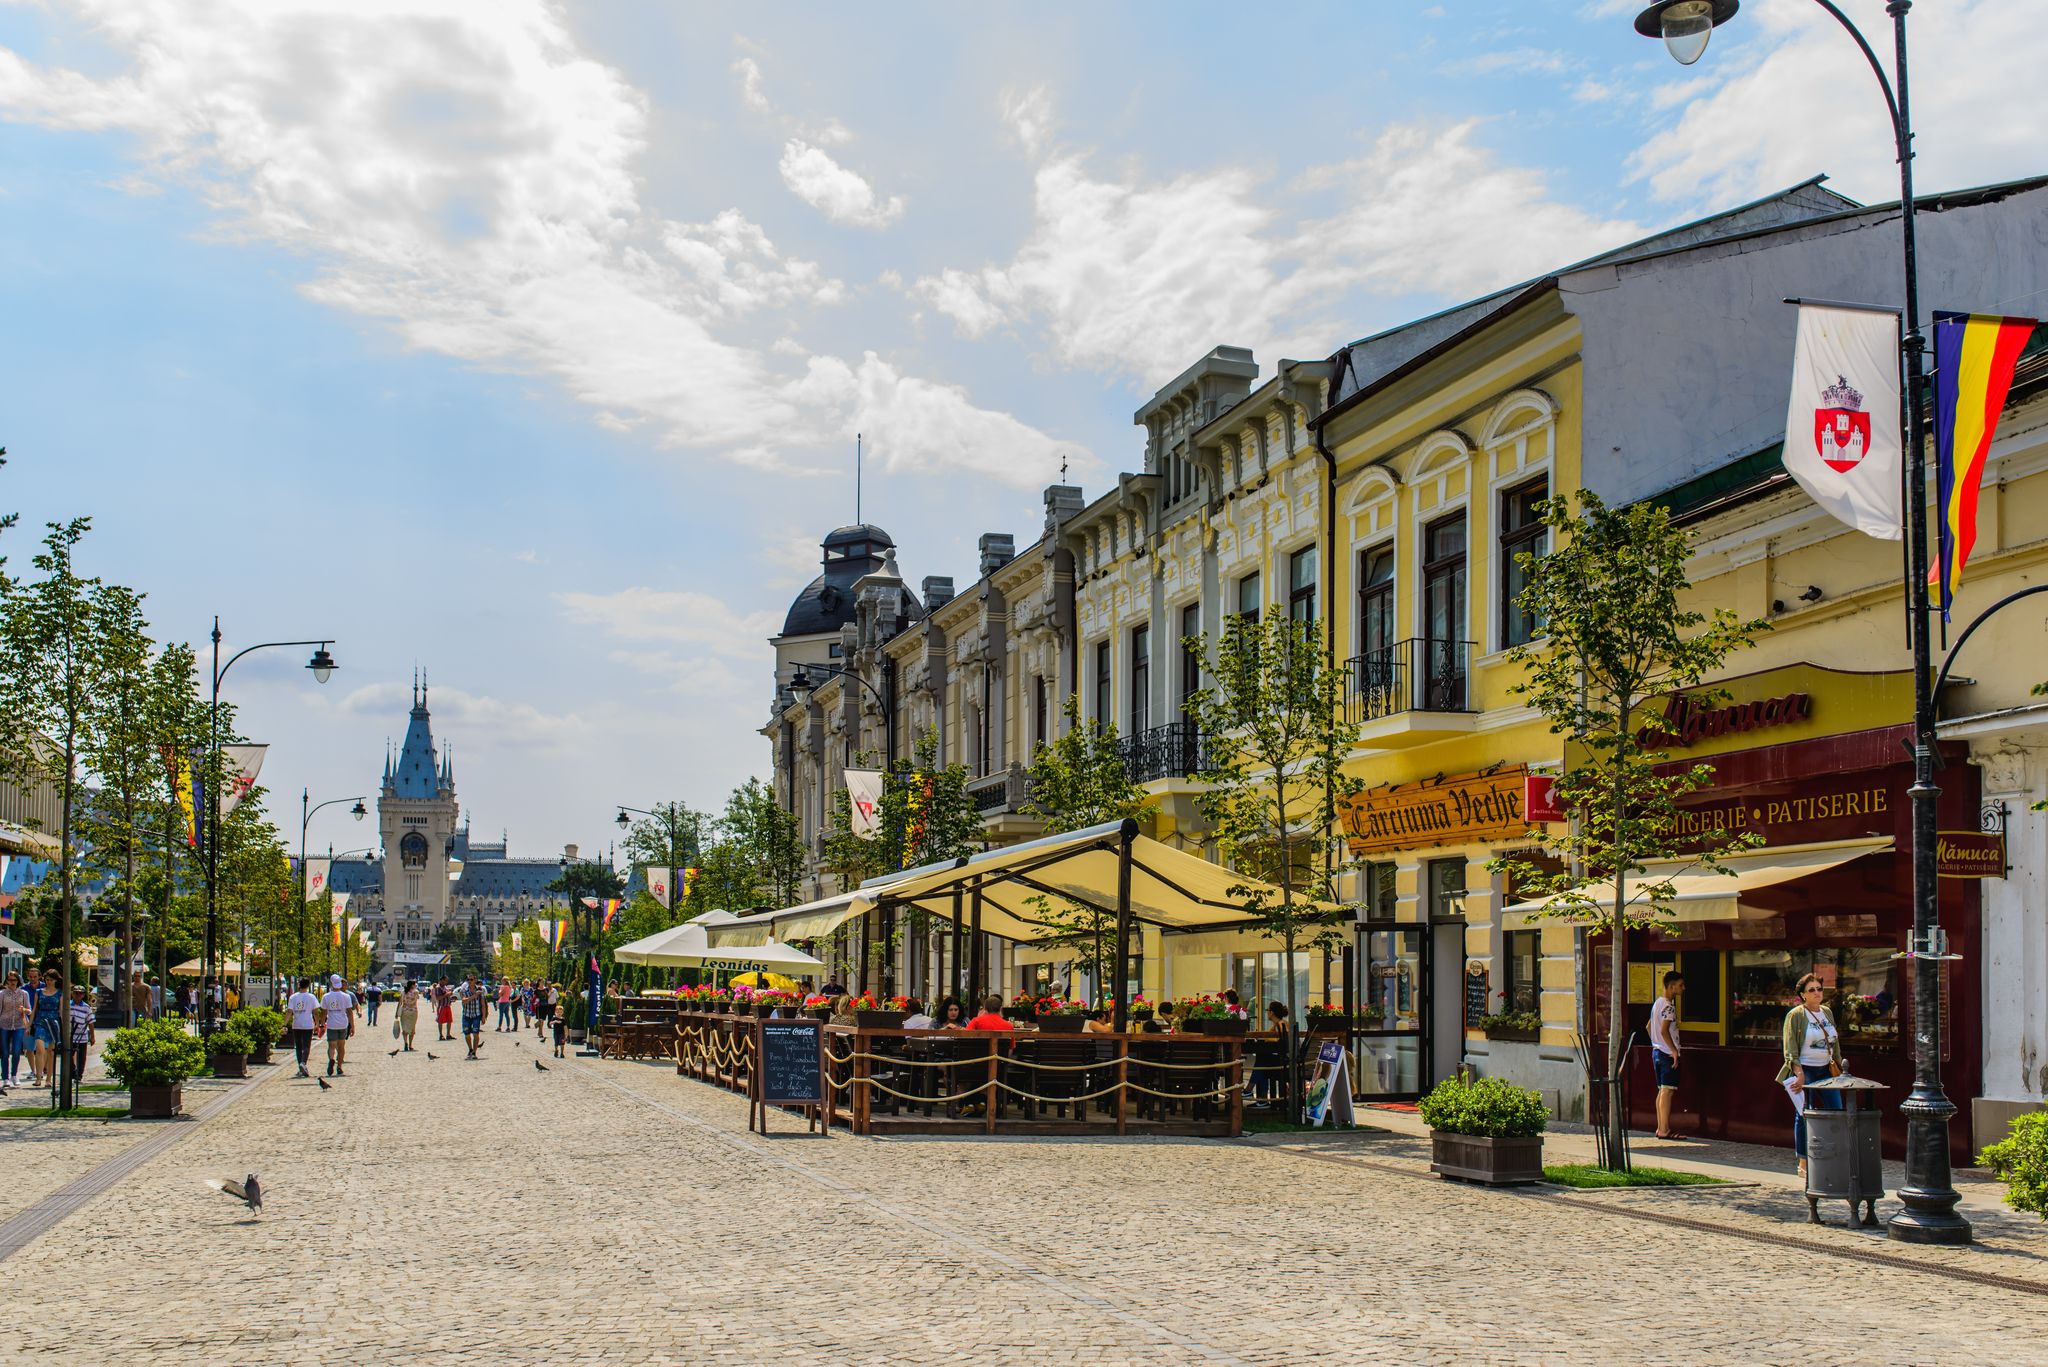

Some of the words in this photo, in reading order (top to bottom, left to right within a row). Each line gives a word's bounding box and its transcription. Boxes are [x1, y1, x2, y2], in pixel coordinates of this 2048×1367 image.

[1351, 802, 1452, 840] Cârciuma
[1448, 783, 1522, 829] Veche
[1767, 788, 1888, 825] PATISERIE
[1936, 838, 2000, 863] Mămuca
[700, 957, 769, 972] Leonidas
